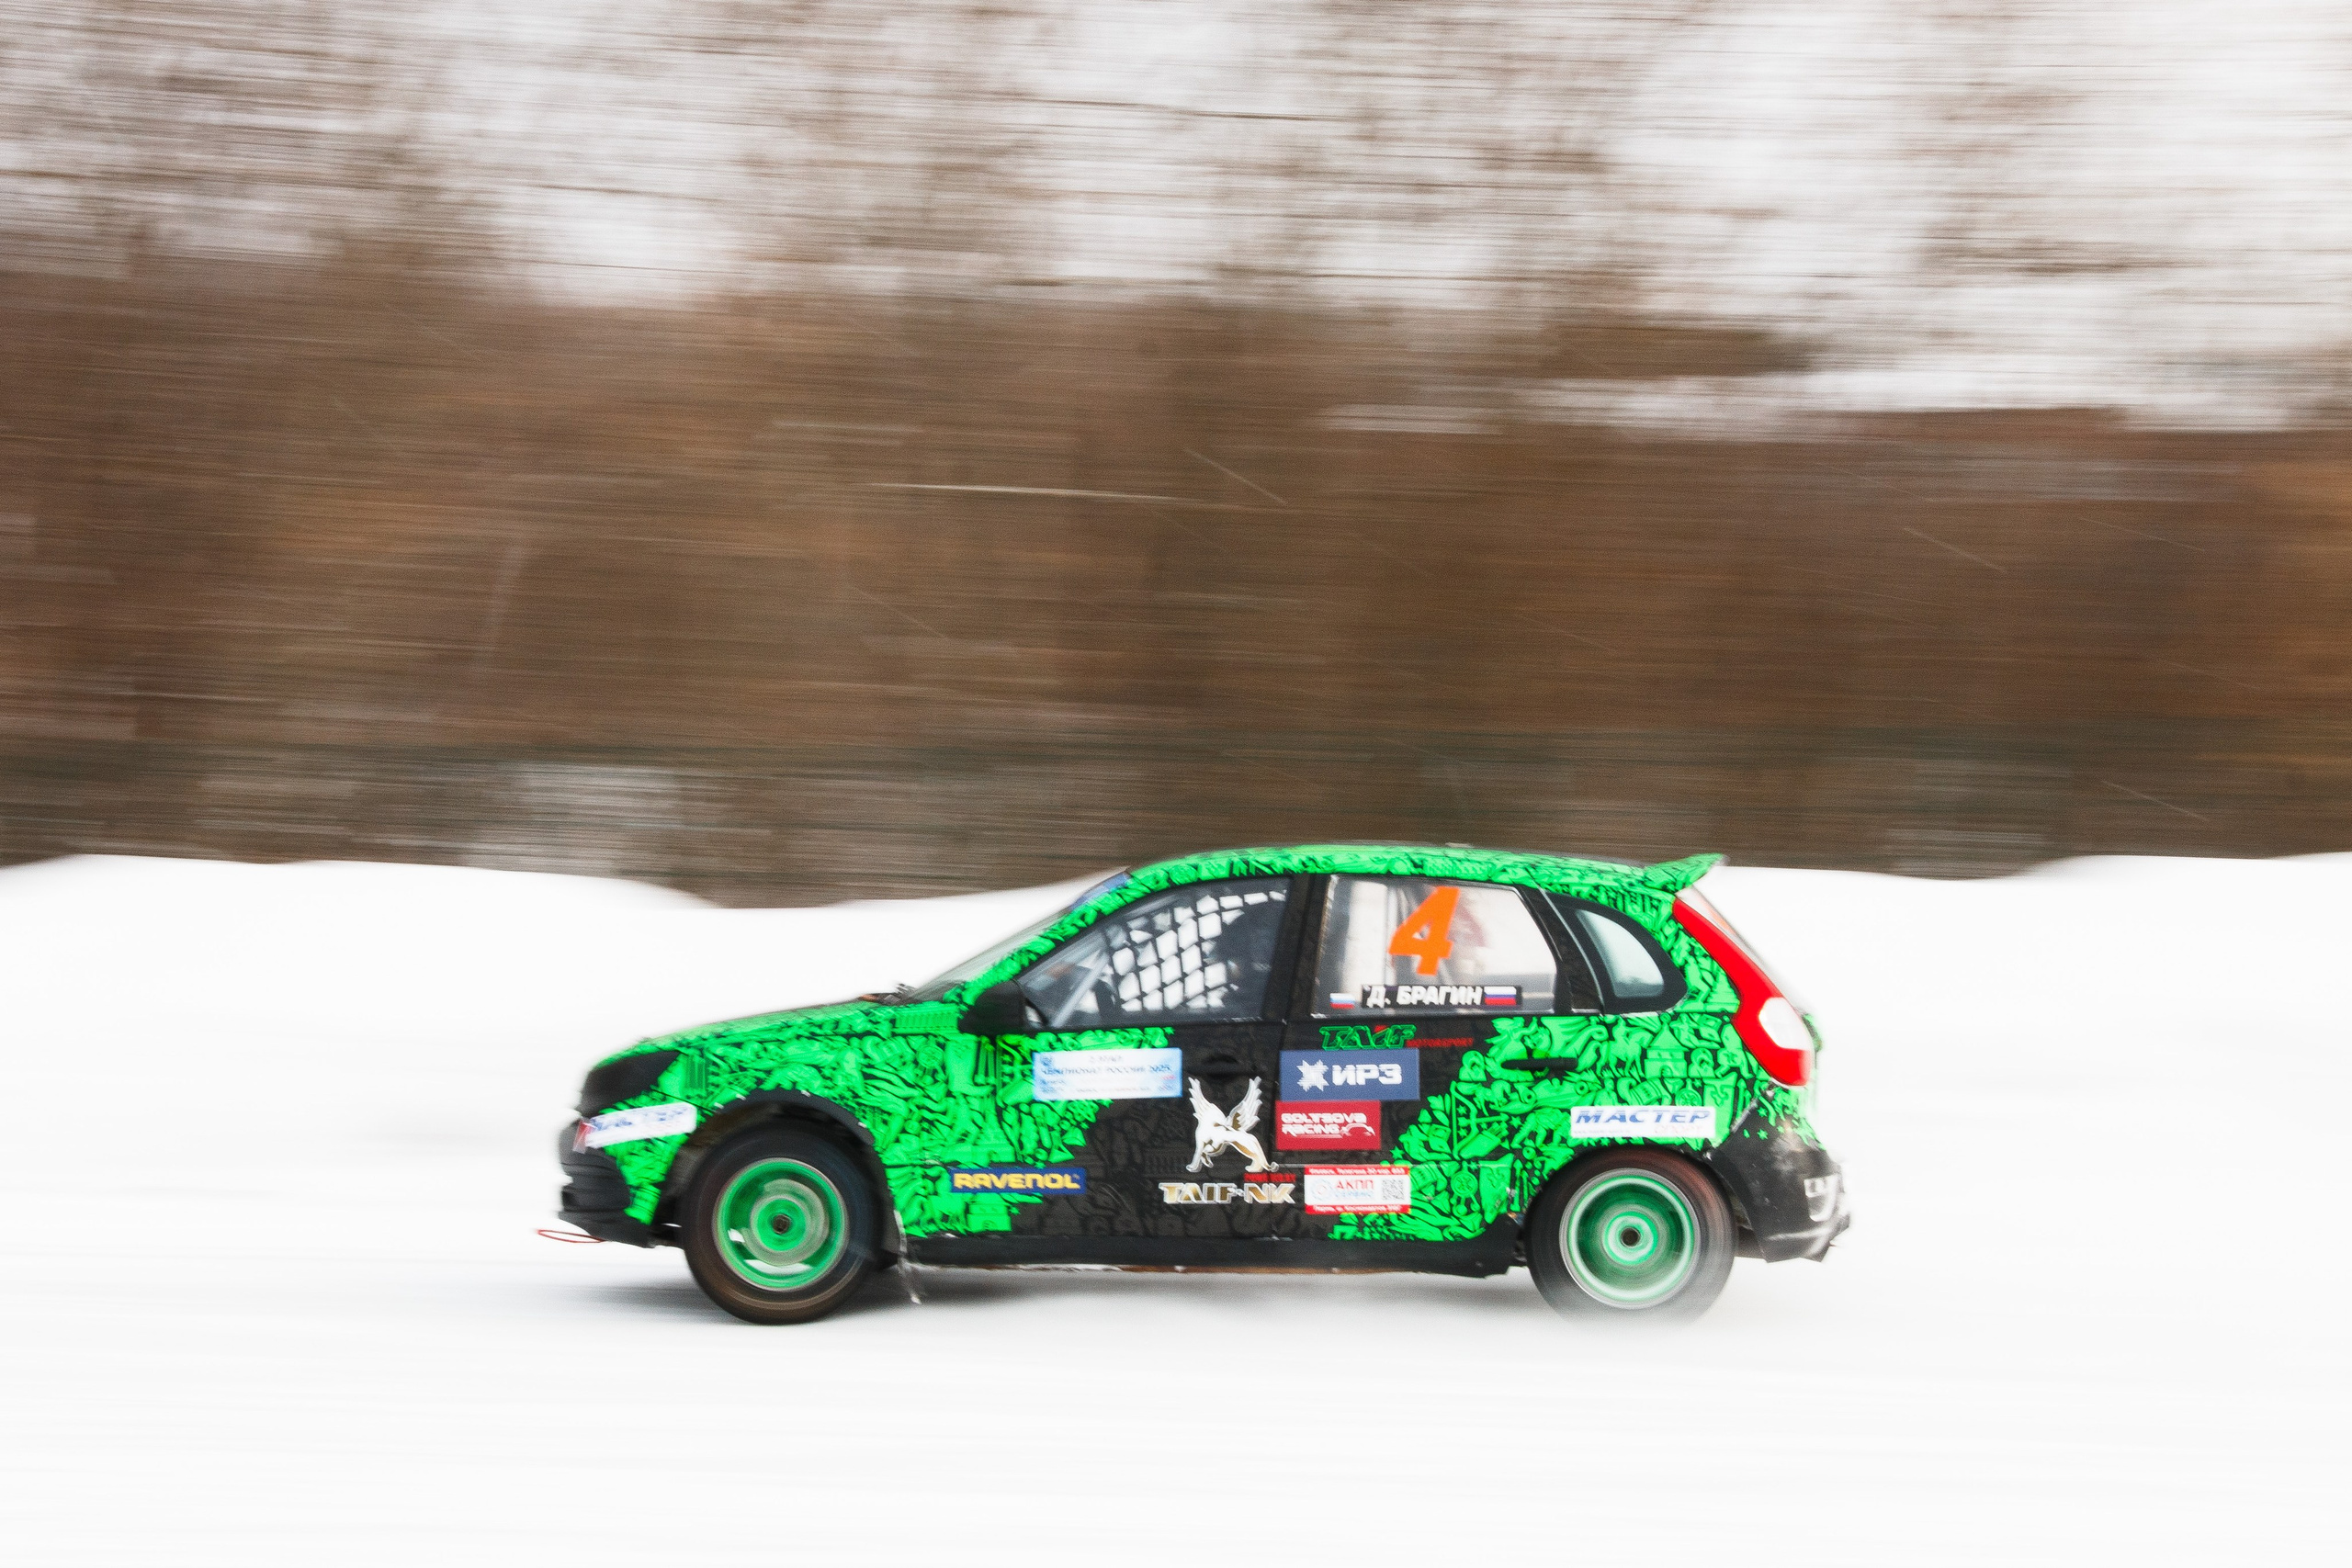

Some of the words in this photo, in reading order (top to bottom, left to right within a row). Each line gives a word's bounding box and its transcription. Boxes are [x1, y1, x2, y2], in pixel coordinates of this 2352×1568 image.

[1387, 885, 1461, 976] 4
[1366, 985, 1391, 1009] Д.
[1396, 985, 1483, 1006] БРАГИН
[1318, 1024, 1417, 1050] TAIF
[1576, 1110, 1711, 1124] МАСТЕР
[1281, 1123, 1341, 1137] RACING
[953, 1173, 1081, 1190] RAVENOL
